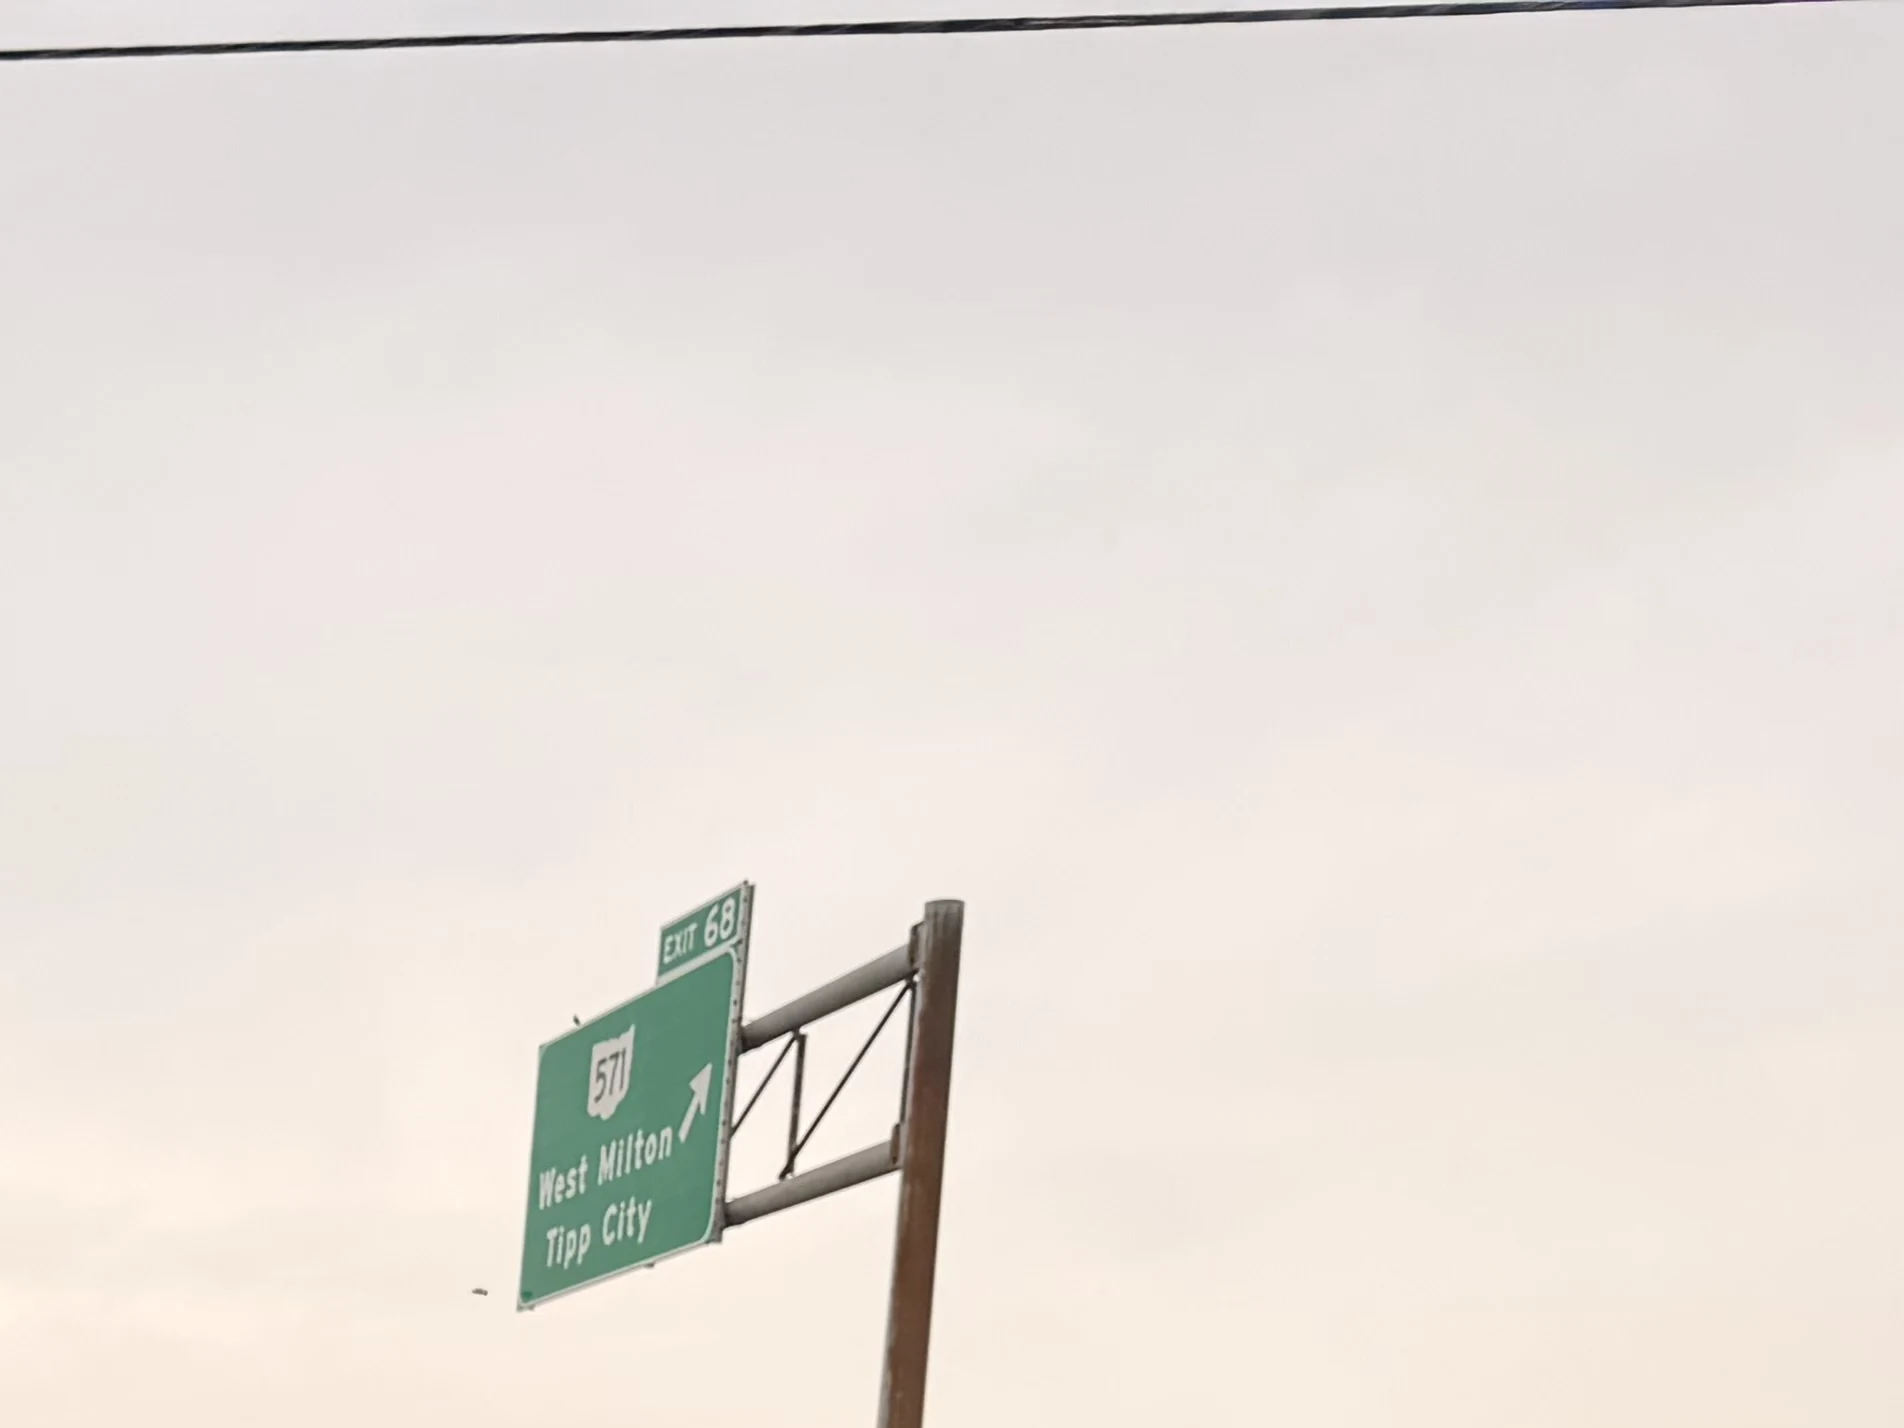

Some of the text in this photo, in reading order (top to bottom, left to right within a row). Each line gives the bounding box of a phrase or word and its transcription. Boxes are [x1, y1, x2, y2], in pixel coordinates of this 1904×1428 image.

[663, 896, 736, 965] EXIT 68
[594, 1047, 628, 1104] 571
[538, 1125, 674, 1211] West Milton
[546, 1195, 653, 1270] Tipp City
